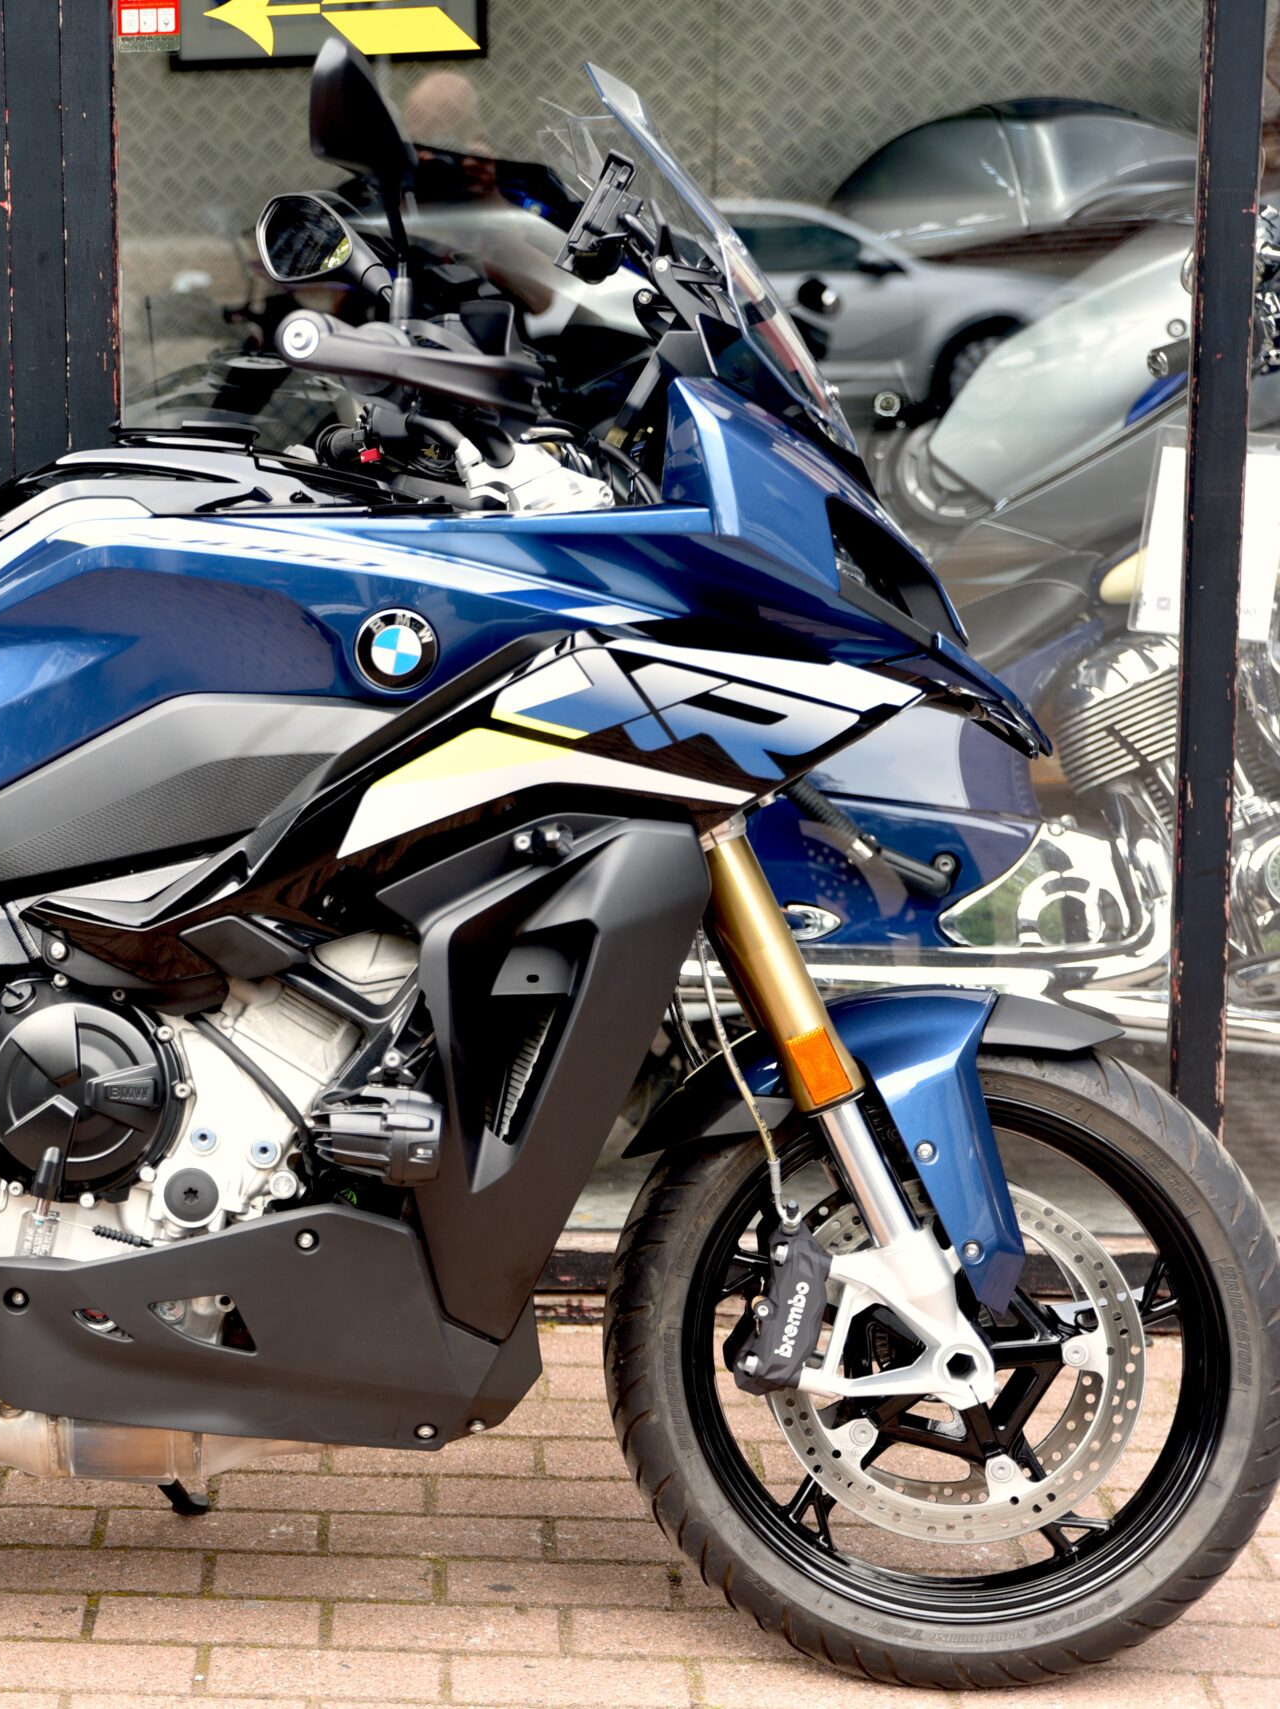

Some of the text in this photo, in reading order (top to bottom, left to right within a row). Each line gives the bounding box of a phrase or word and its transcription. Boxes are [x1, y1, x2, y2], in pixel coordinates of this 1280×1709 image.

[368, 613, 434, 644] BMW
[109, 1085, 150, 1100] BMW
[774, 1281, 810, 1359] brembo
[1219, 1263, 1253, 1387] BRIDGESTONE
[1033, 1589, 1121, 1637] BATTLAX
